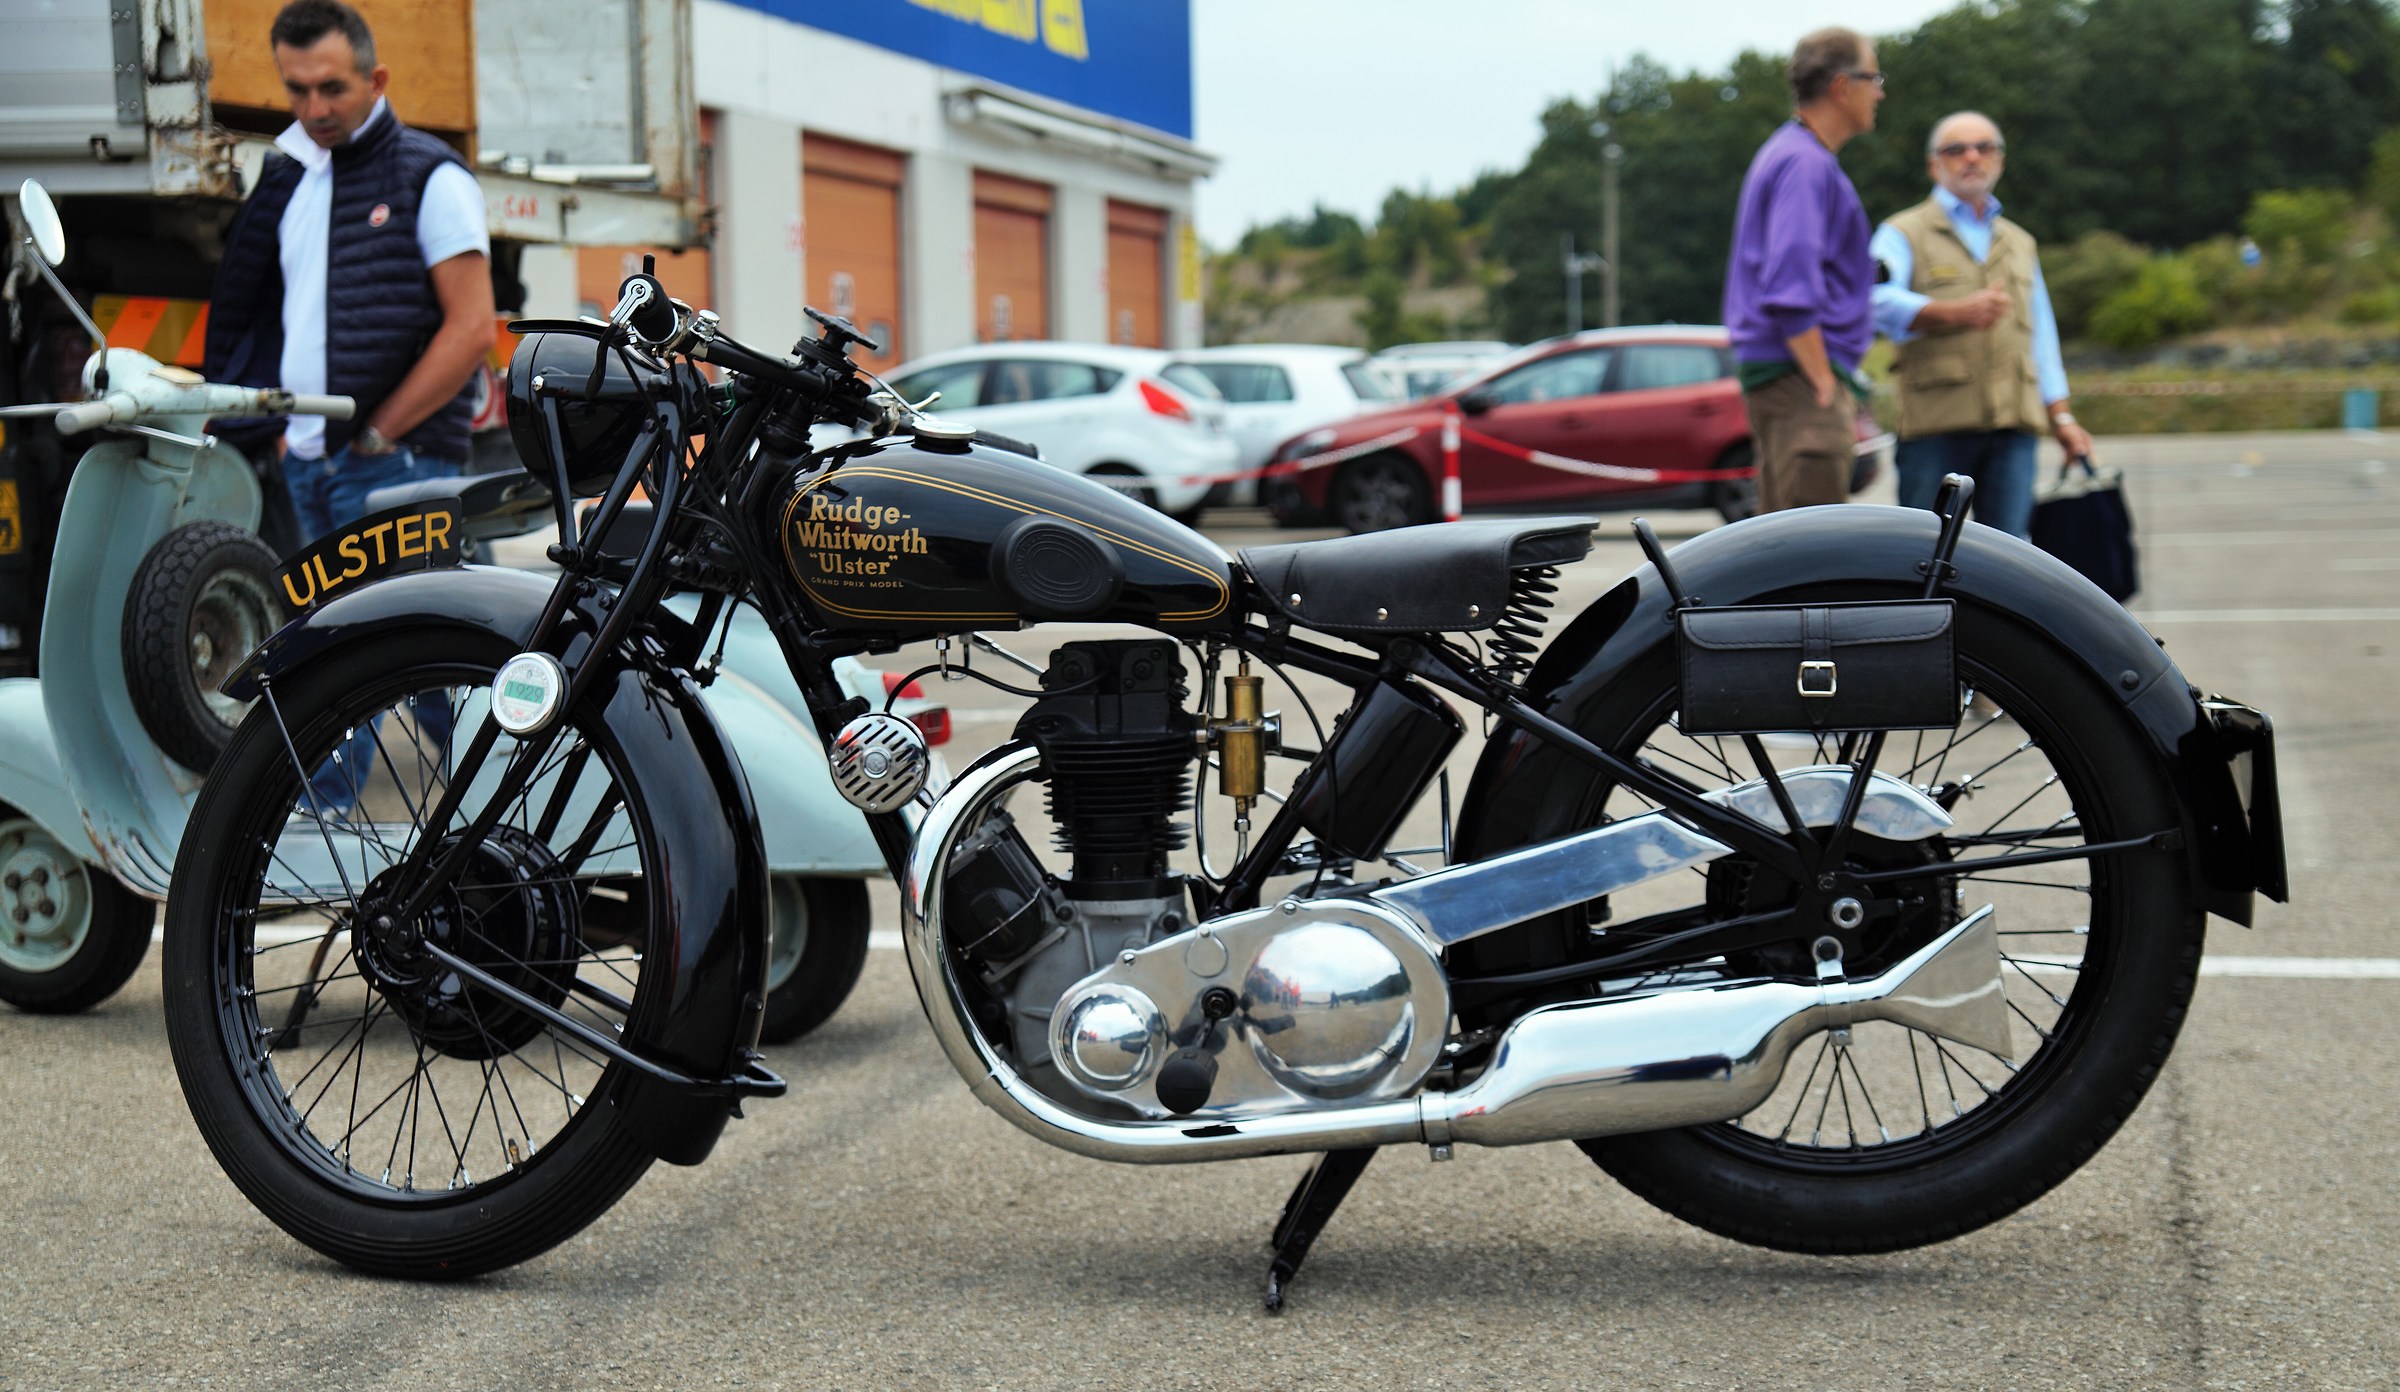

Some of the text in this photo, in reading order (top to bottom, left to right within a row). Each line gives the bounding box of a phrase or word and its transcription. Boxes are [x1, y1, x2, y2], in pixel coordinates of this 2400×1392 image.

[809, 495, 911, 530] Rudge-
[797, 521, 928, 554] Whitworth
[282, 511, 452, 606] ULSTER
[811, 577, 840, 586] GRAND
[508, 681, 543, 702] 1929
